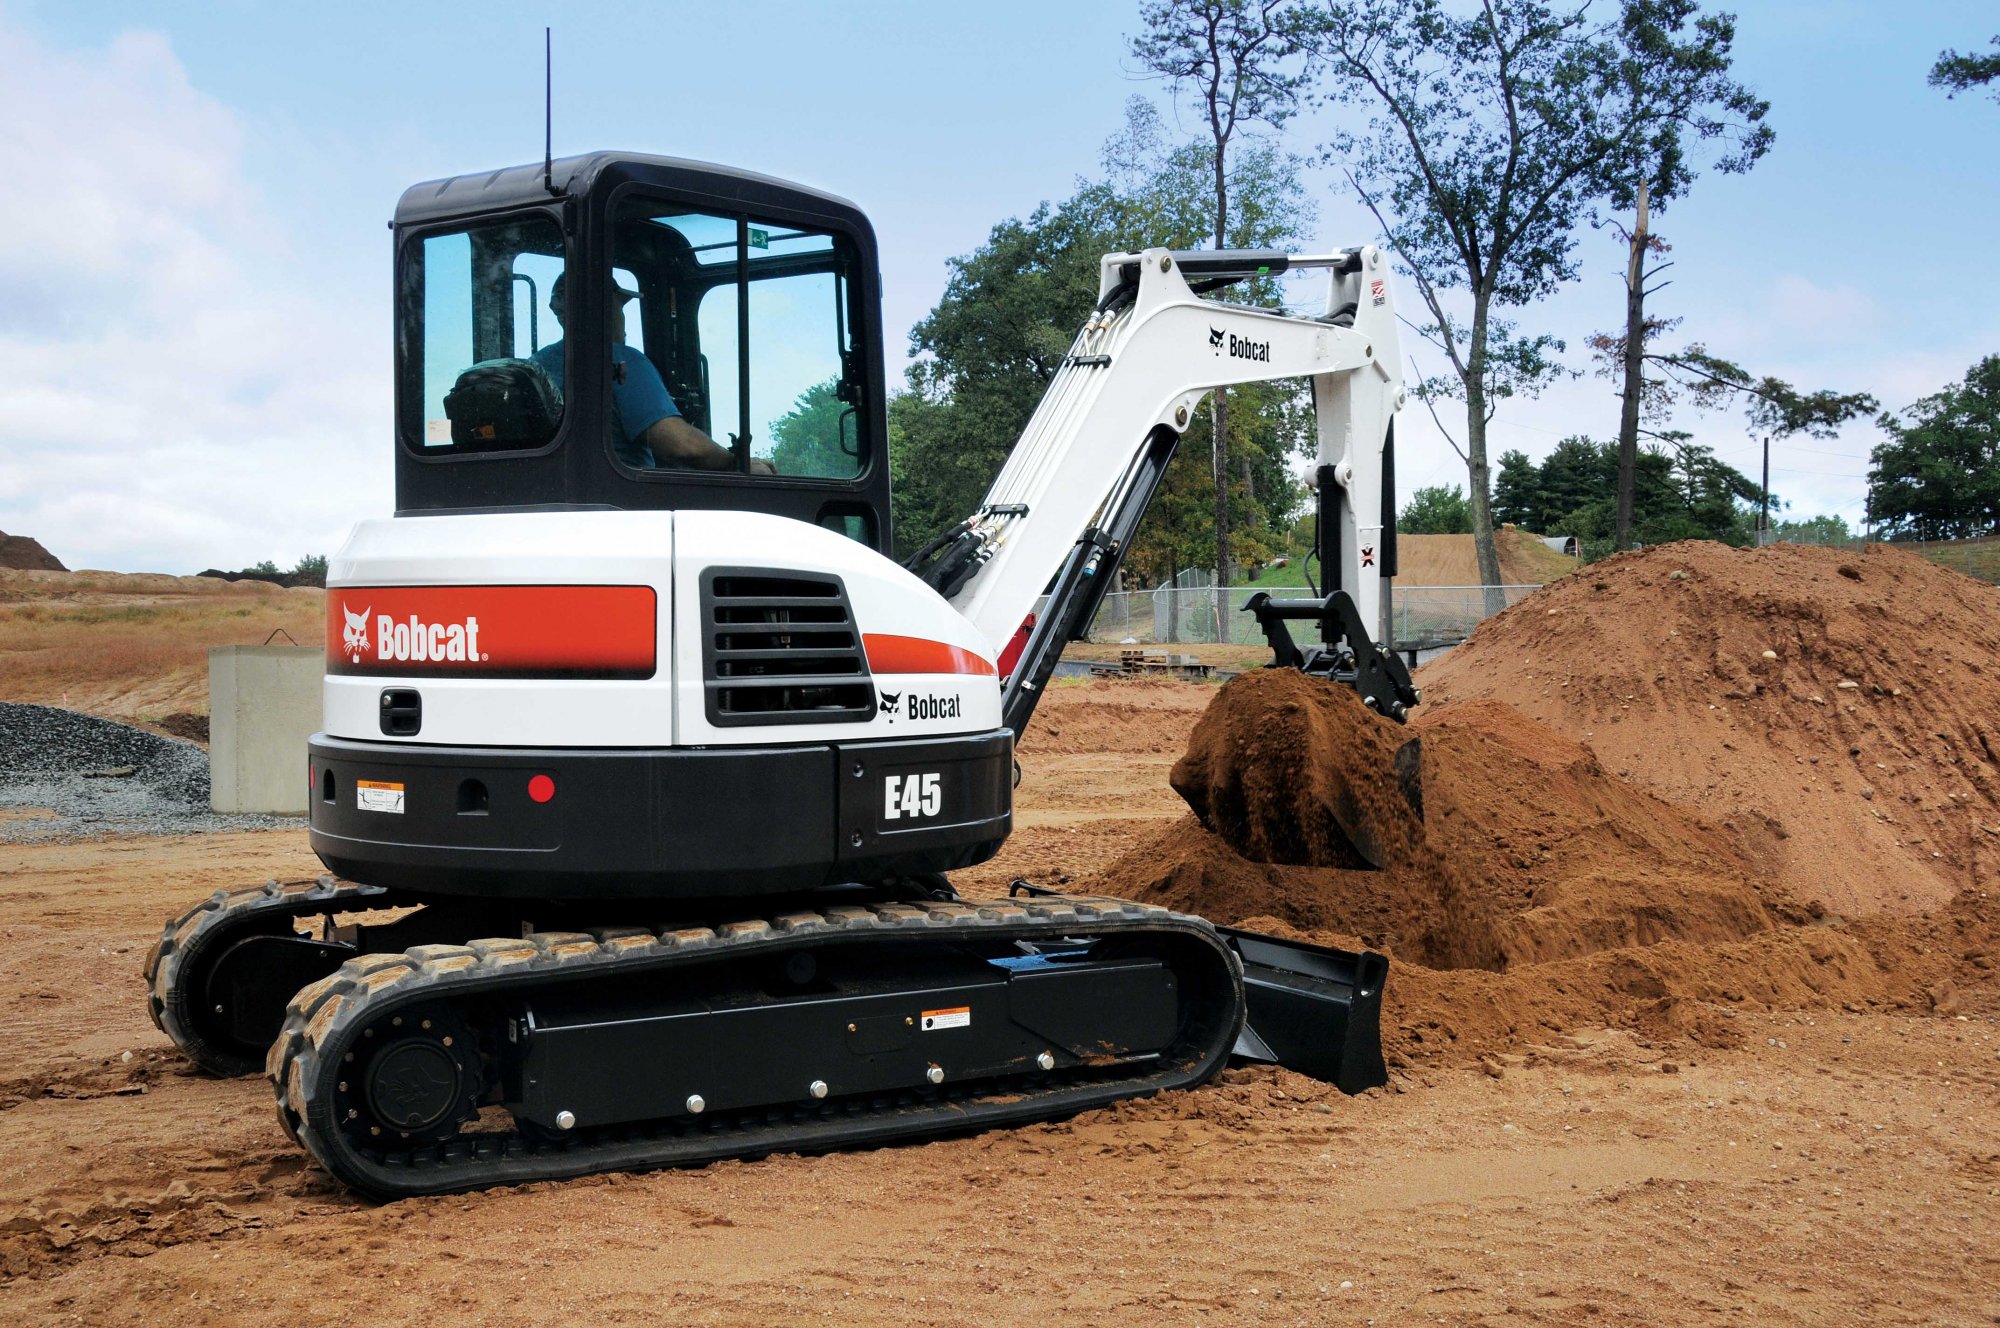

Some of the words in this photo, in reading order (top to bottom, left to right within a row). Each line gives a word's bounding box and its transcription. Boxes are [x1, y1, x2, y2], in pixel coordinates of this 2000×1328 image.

[1230, 334, 1269, 363] Bobcat
[377, 614, 479, 662] Bobcat
[908, 694, 961, 720] Bobcat
[885, 773, 942, 819] E45
